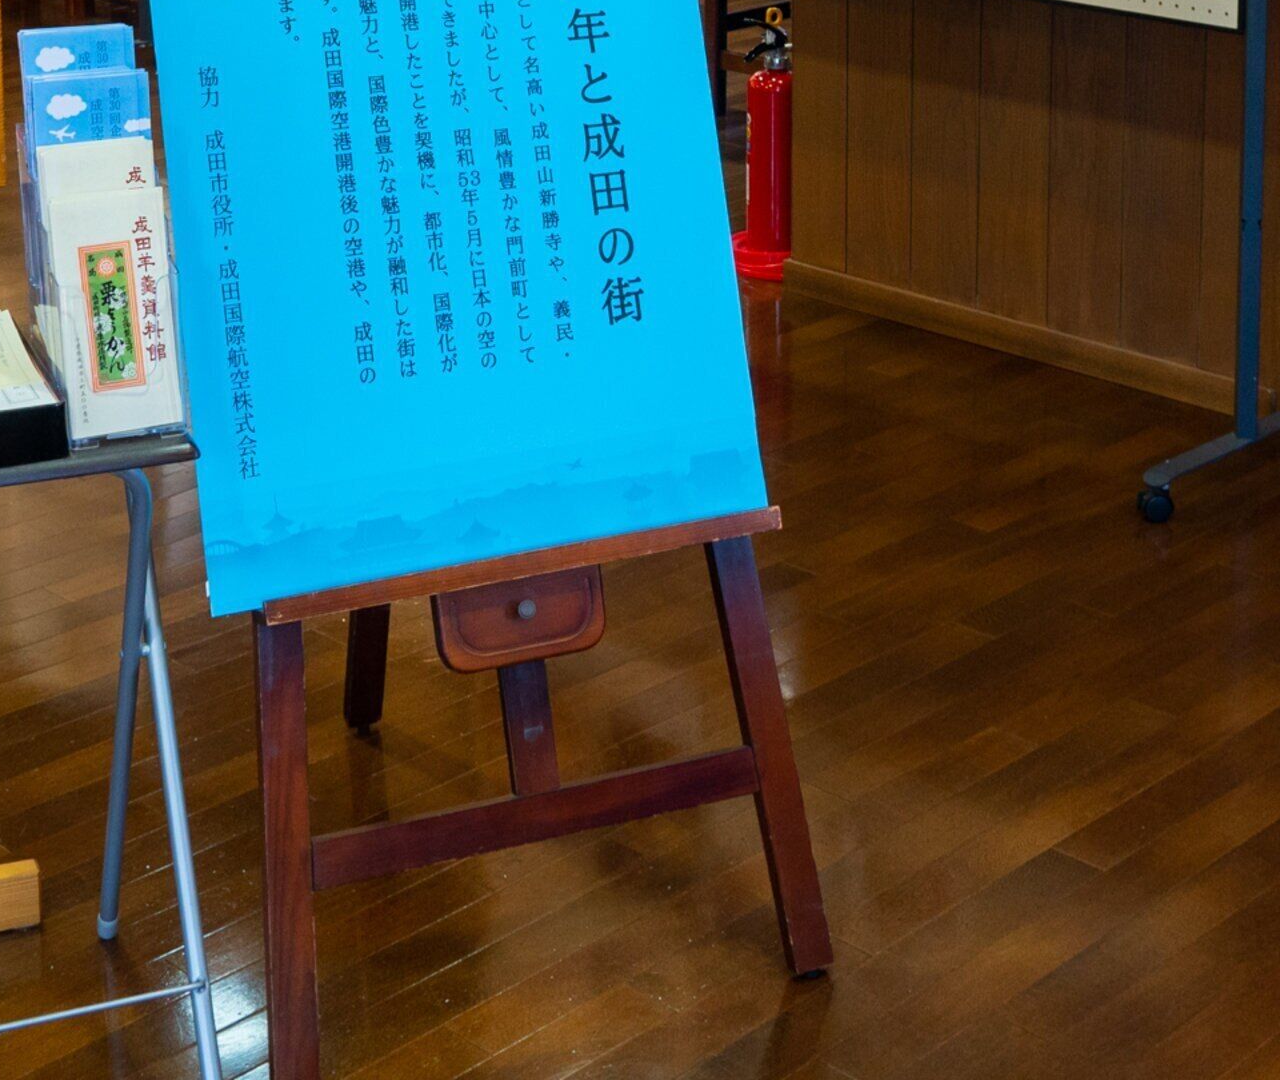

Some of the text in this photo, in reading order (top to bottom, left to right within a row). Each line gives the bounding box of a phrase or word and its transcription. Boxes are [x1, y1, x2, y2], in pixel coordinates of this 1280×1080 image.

[96, 40, 110, 69] 第30
[90, 98, 105, 141] 成田空
[198, 66, 261, 480] 協力 成田市役所・成田国際航空株式会社
